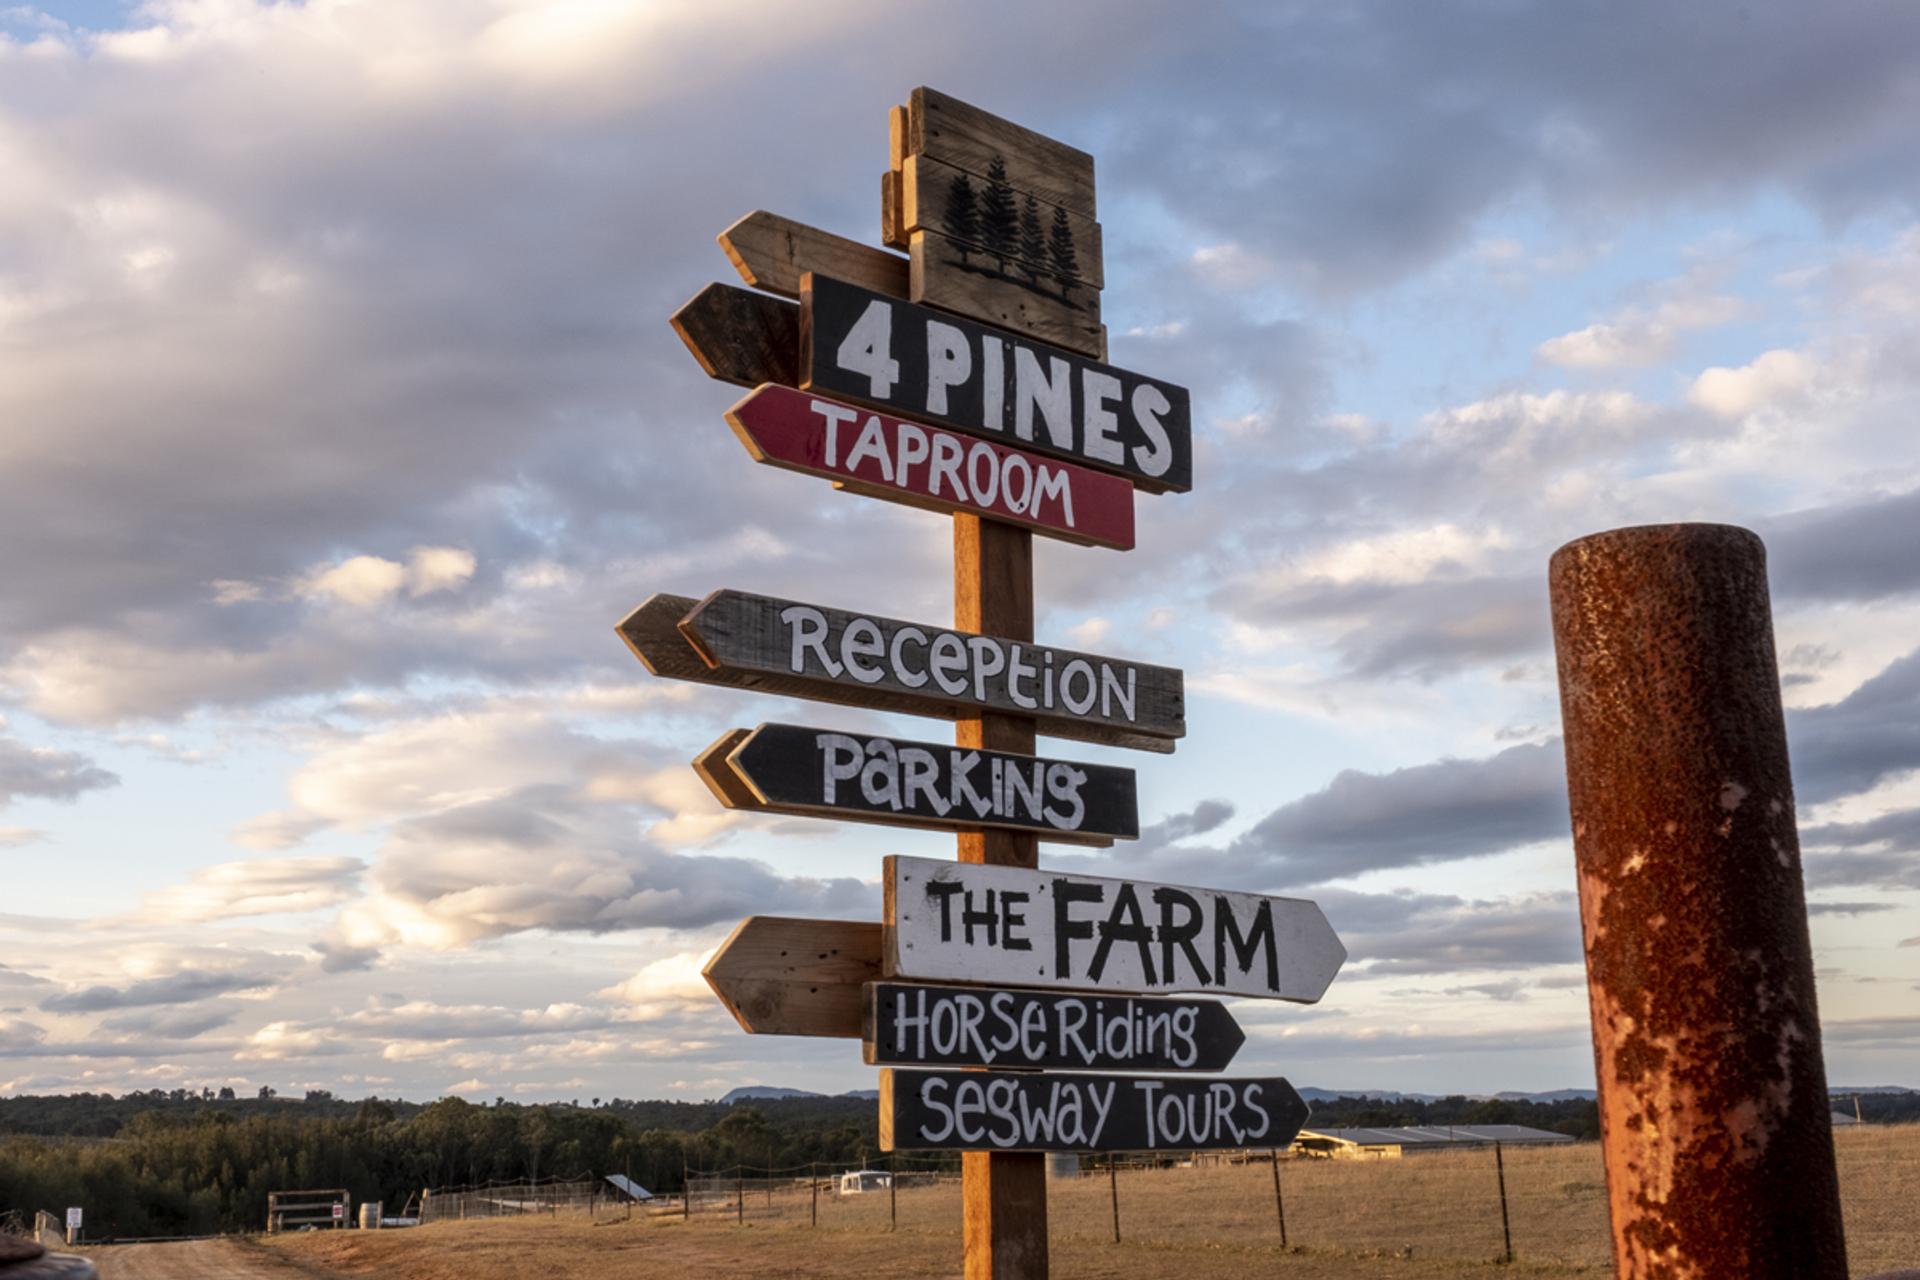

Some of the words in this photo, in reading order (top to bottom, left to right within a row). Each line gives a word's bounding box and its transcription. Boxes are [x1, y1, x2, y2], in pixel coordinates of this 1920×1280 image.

[837, 300, 900, 399] 4
[926, 320, 1173, 477] PINES
[810, 400, 1075, 528] TAPROOM
[926, 880, 1033, 952] THE
[1051, 877, 1281, 993] FARM
[1053, 1000, 1199, 1068] Riding
